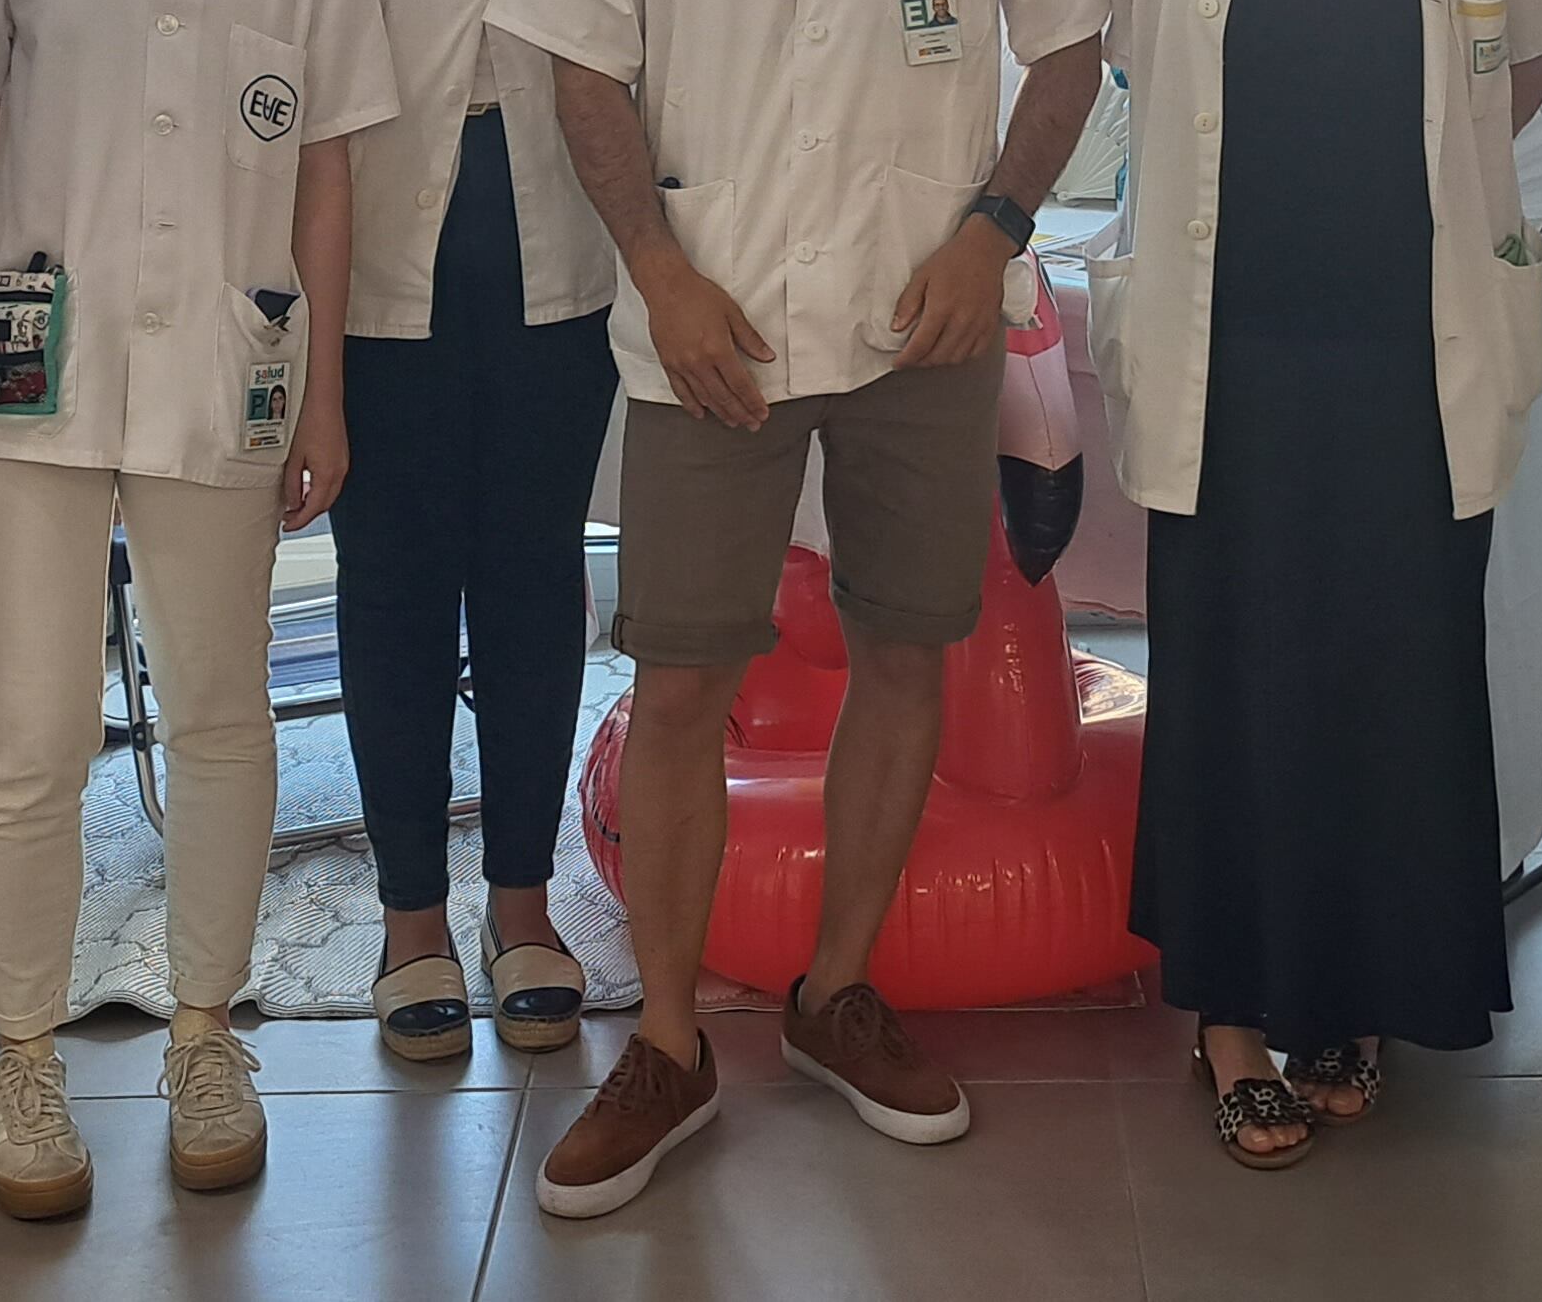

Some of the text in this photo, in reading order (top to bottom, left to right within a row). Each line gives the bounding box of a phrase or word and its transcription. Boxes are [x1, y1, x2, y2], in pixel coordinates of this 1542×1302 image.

[905, 0, 926, 28] E
[255, 363, 285, 379] salud
[251, 393, 266, 416] P
